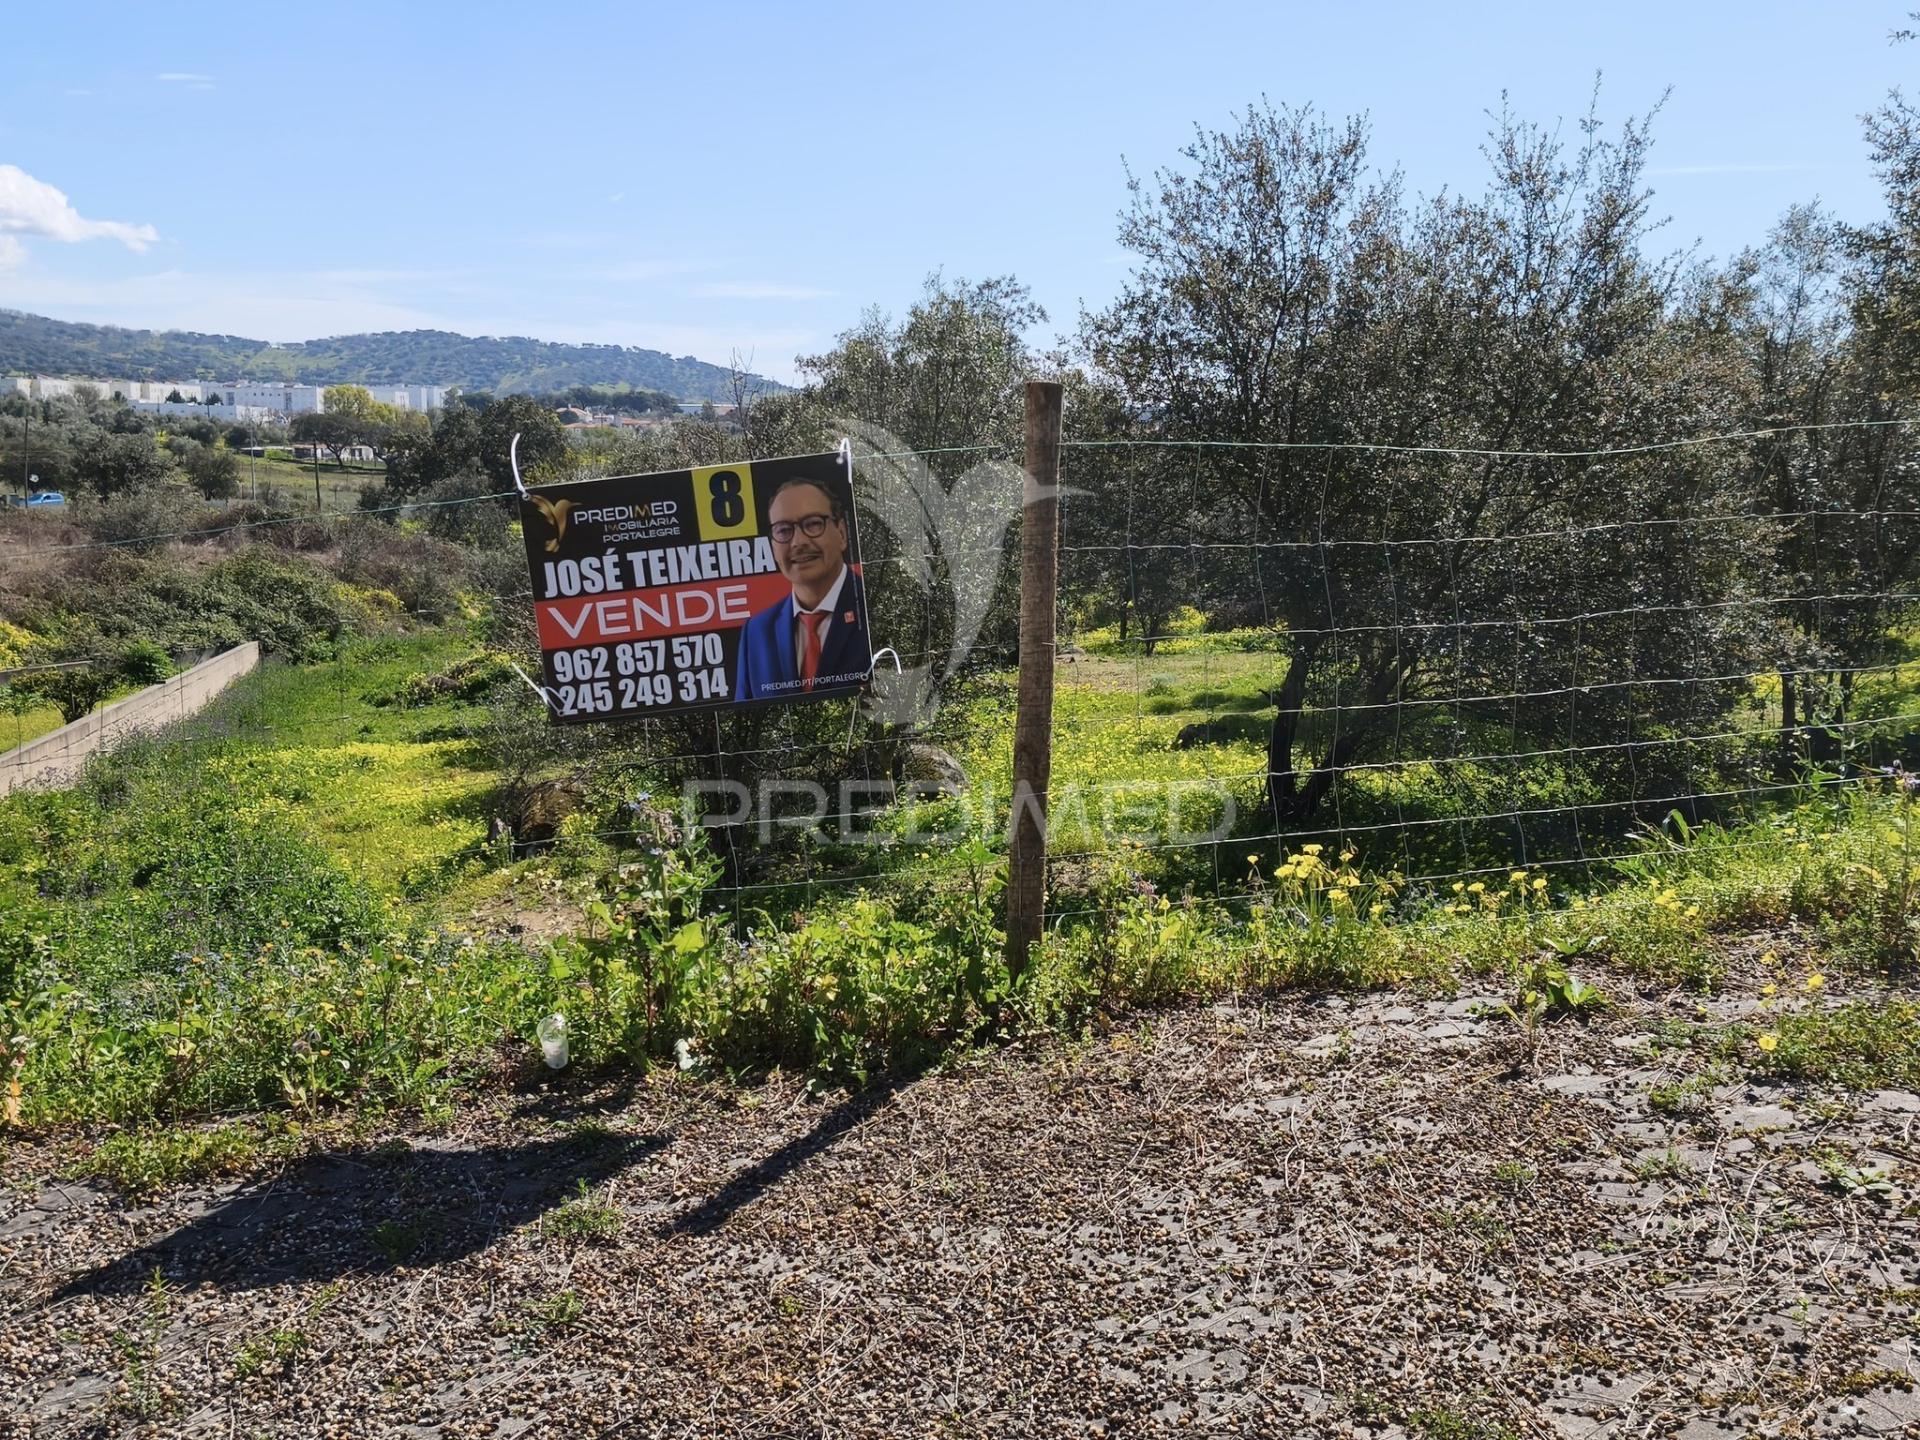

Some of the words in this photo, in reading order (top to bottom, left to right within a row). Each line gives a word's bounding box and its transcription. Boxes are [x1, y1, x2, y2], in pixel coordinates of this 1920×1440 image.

[573, 500, 678, 525] PREDIMED
[604, 516, 679, 532] IMOBILIARIA
[709, 470, 745, 528] 8
[602, 526, 681, 543] PORTALEGRE
[543, 546, 622, 599] JOSÉ
[626, 535, 777, 588] TEIXEIRA
[547, 583, 751, 640] VENDE
[553, 646, 611, 683] 962
[615, 639, 666, 676] 857
[672, 632, 724, 669] 570
[559, 681, 614, 716] 245
[618, 674, 673, 709] 249
[677, 666, 729, 702] 314
